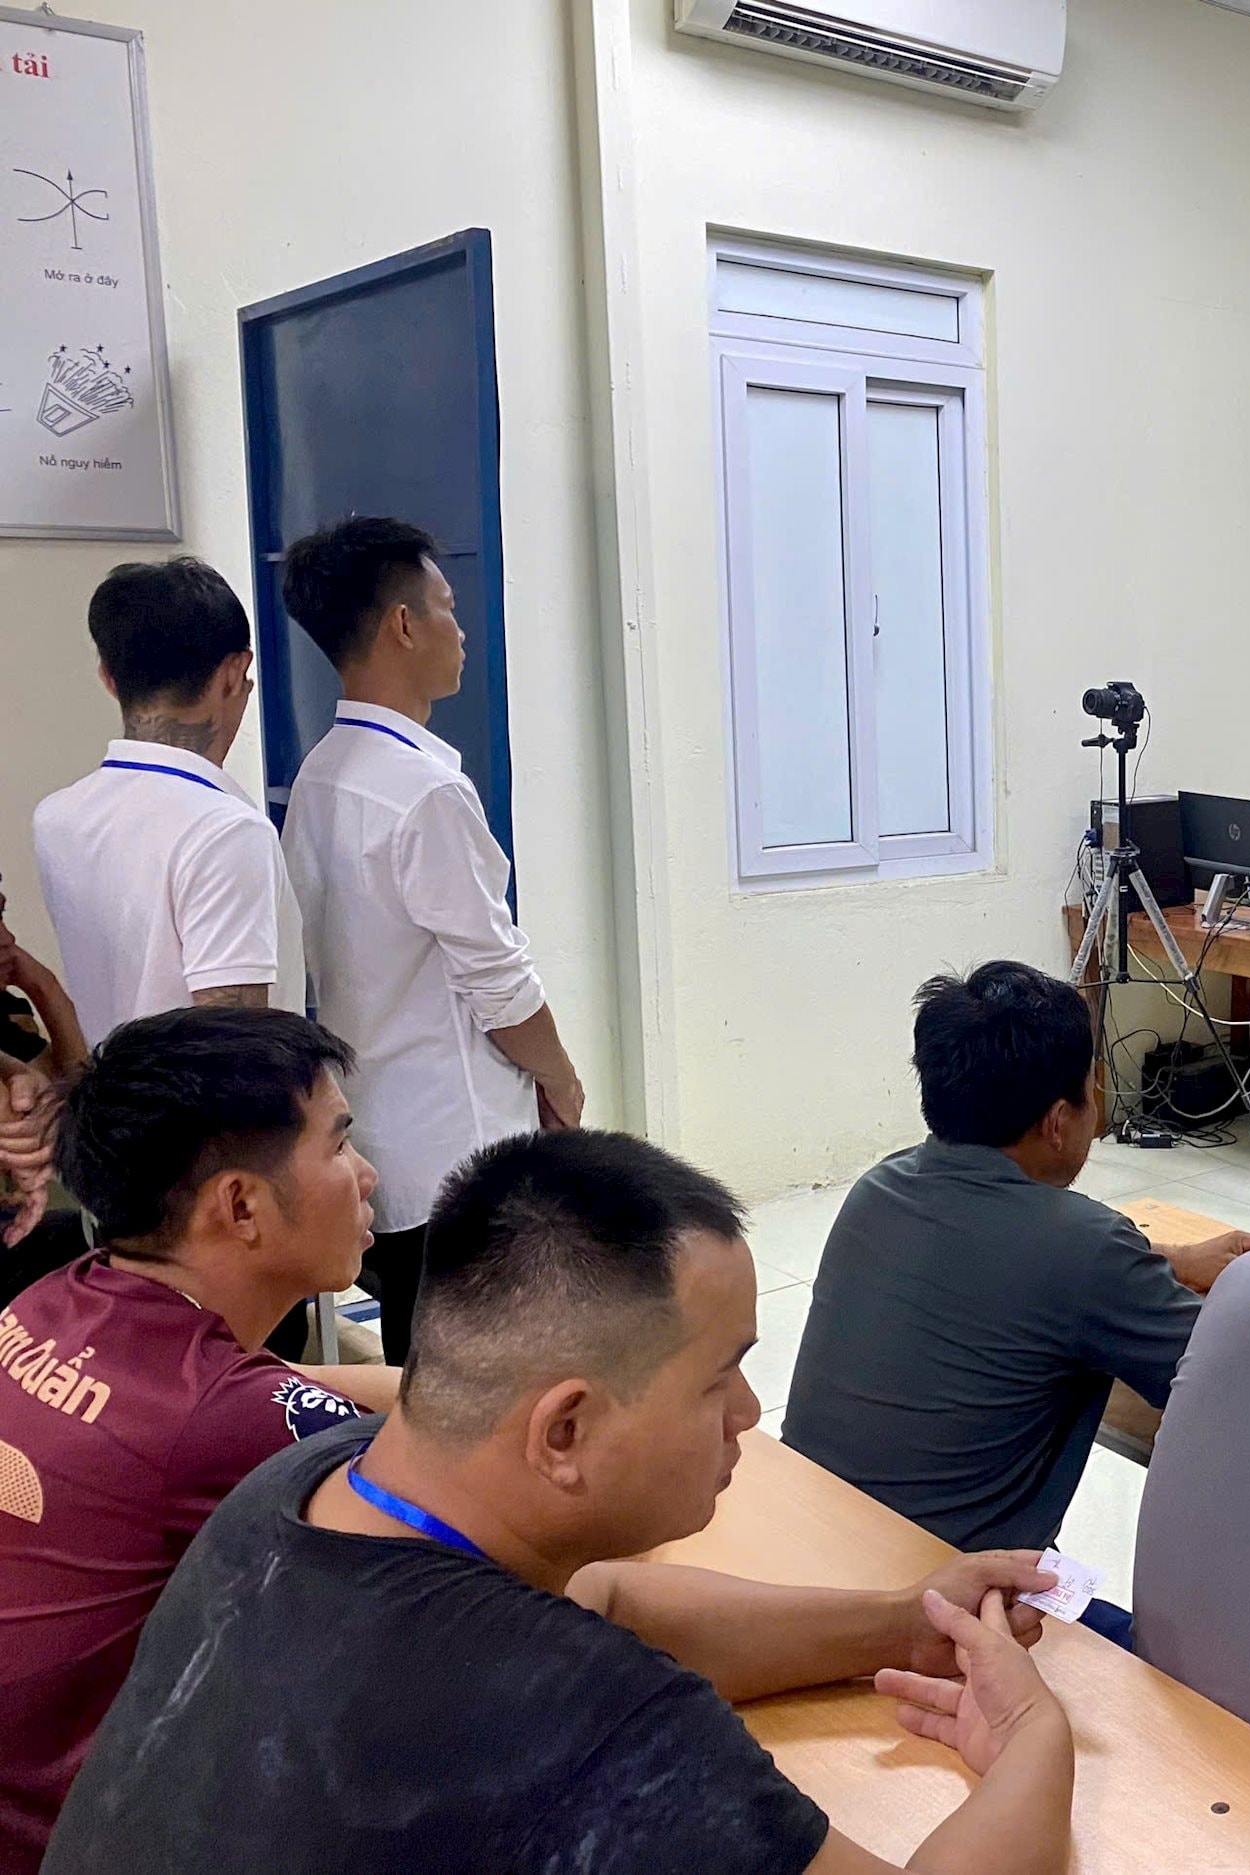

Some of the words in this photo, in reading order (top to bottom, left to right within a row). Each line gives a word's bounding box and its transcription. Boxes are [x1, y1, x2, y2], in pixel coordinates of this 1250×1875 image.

[12, 52, 49, 78] tải
[68, 273, 81, 283] ra
[61, 458, 90, 470] nguy
